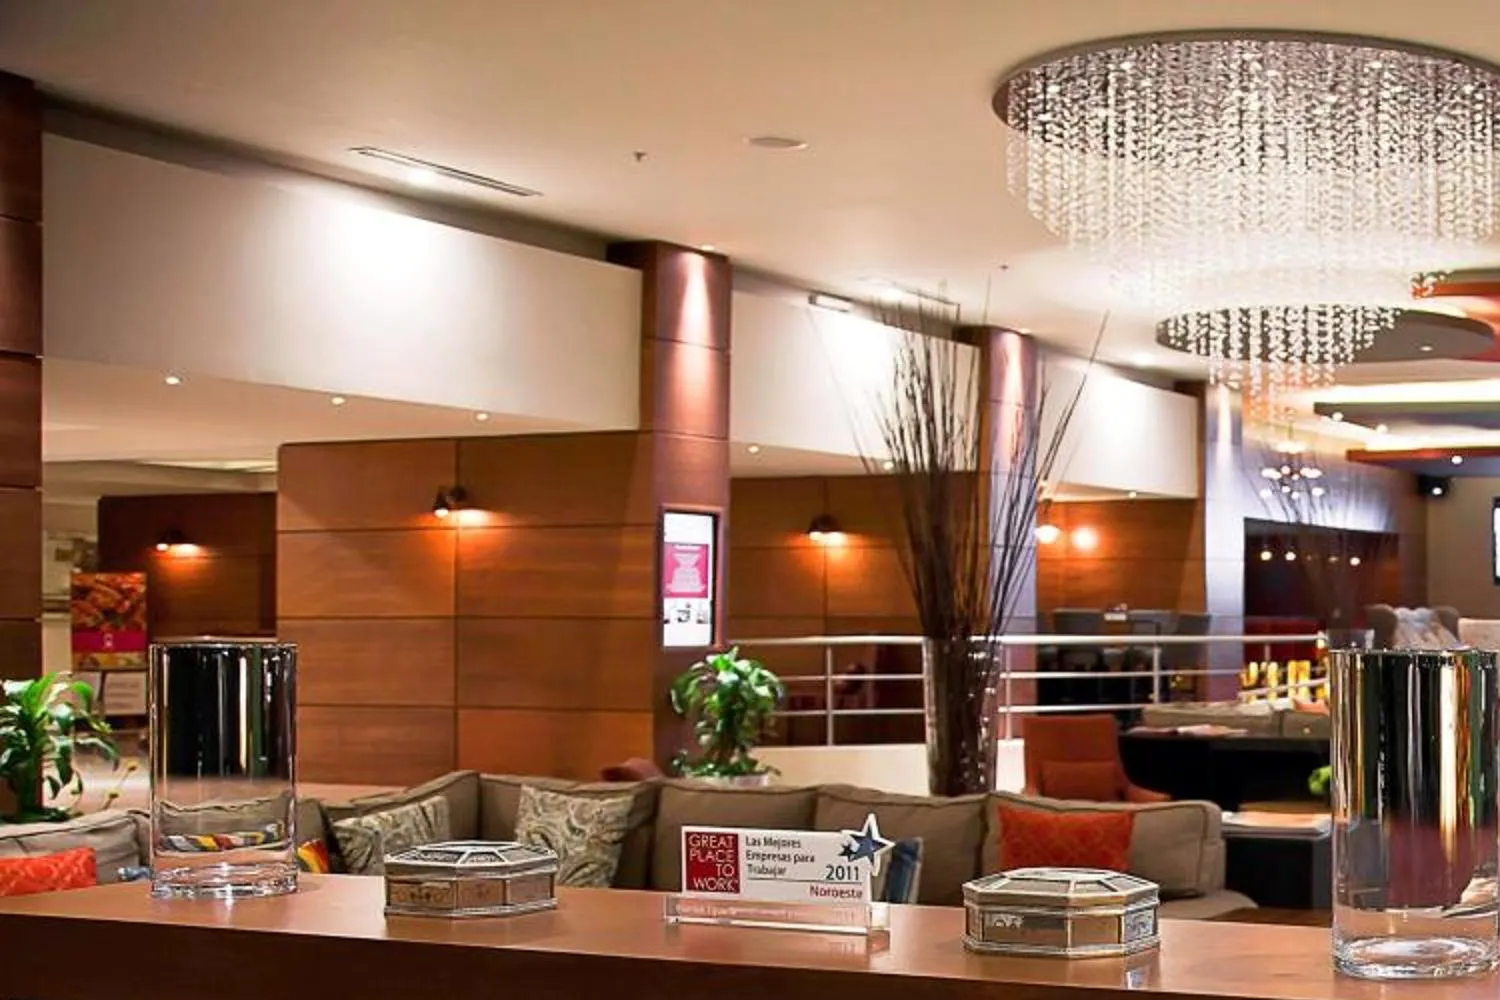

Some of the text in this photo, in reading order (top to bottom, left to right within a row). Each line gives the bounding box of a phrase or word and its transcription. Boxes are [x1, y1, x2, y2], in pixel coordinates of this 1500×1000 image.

[688, 834, 734, 849] GREAT
[746, 836, 801, 850] Las Mejores
[689, 848, 735, 863] PLACE
[746, 850, 816, 865] Empresas para
[715, 863, 735, 877] TO
[747, 863, 787, 878] Trabajar
[825, 864, 859, 880] 2011
[693, 877, 735, 891] WORK
[809, 884, 863, 898] Noroeste
